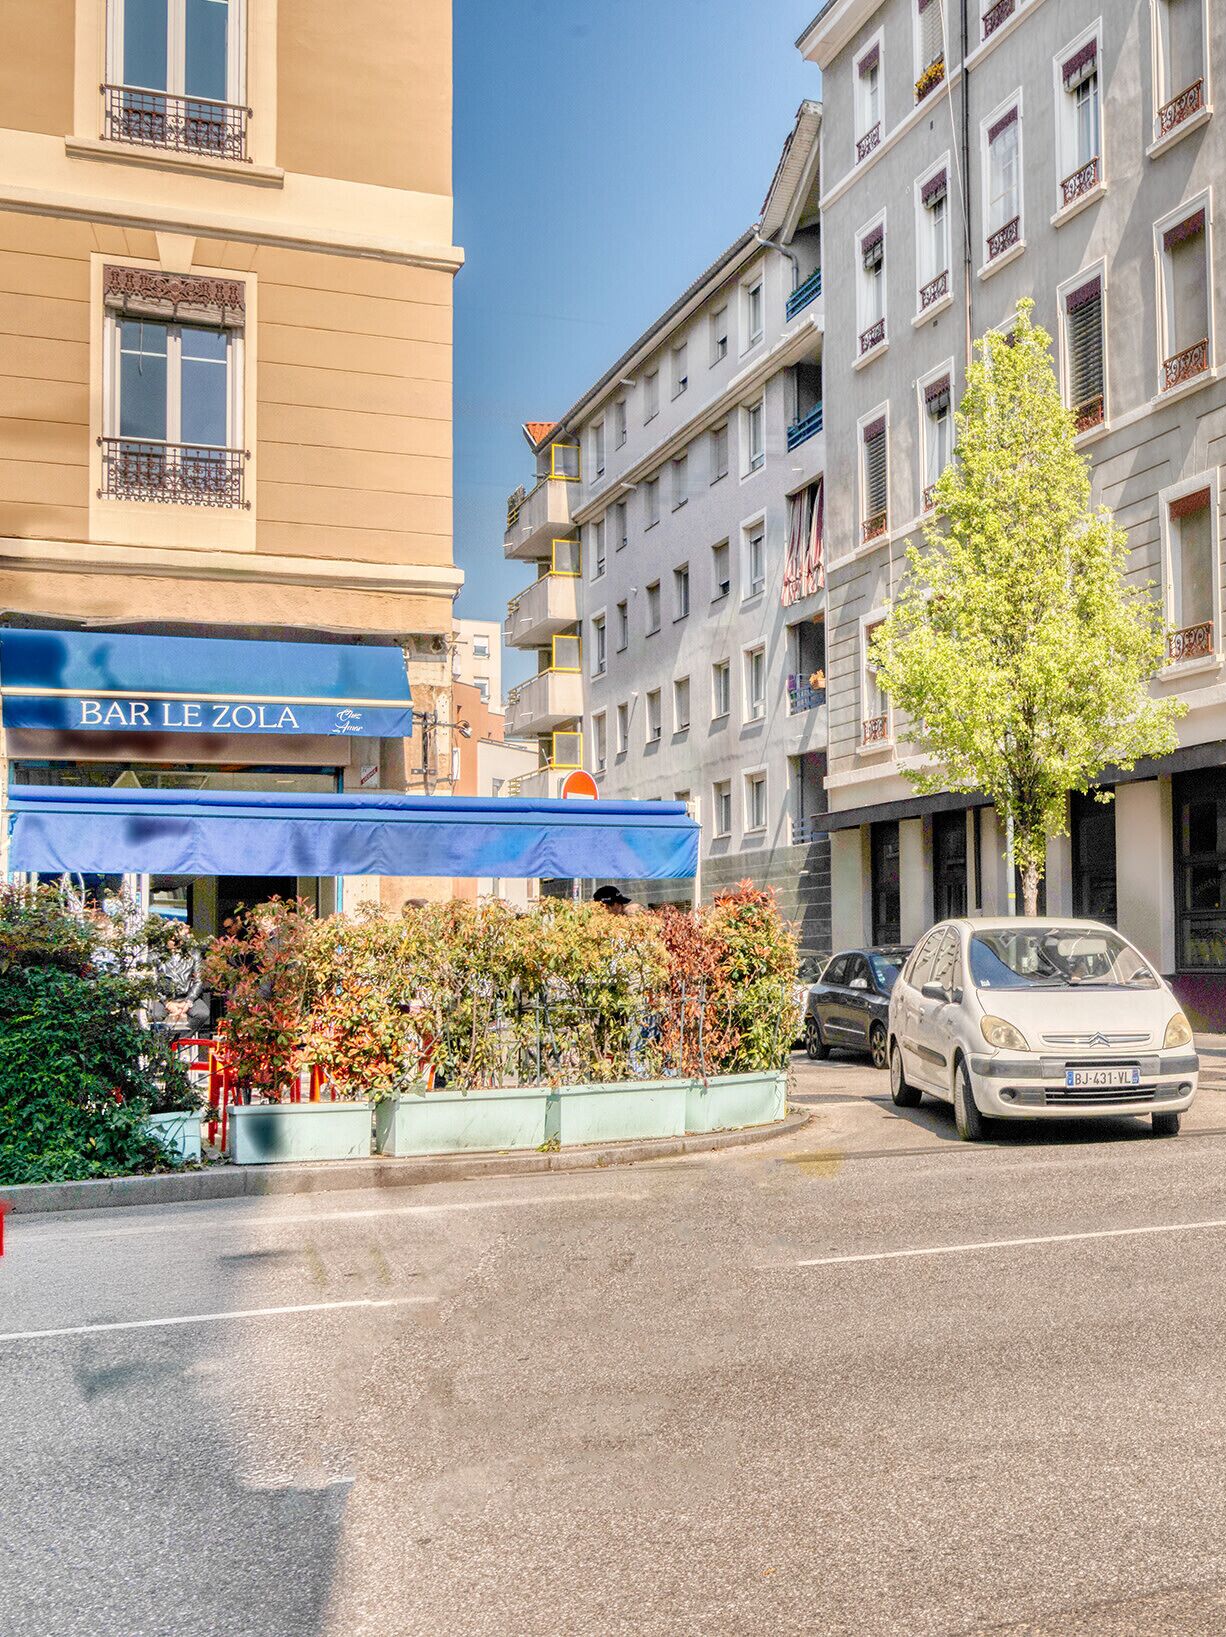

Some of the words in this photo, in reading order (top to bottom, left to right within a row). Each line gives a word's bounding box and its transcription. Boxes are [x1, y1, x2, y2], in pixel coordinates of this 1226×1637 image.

[80, 700, 151, 726] BAR
[162, 703, 202, 727] LE
[212, 705, 299, 729] ZOLA
[1074, 1071, 1131, 1085] BJ-431-VL
